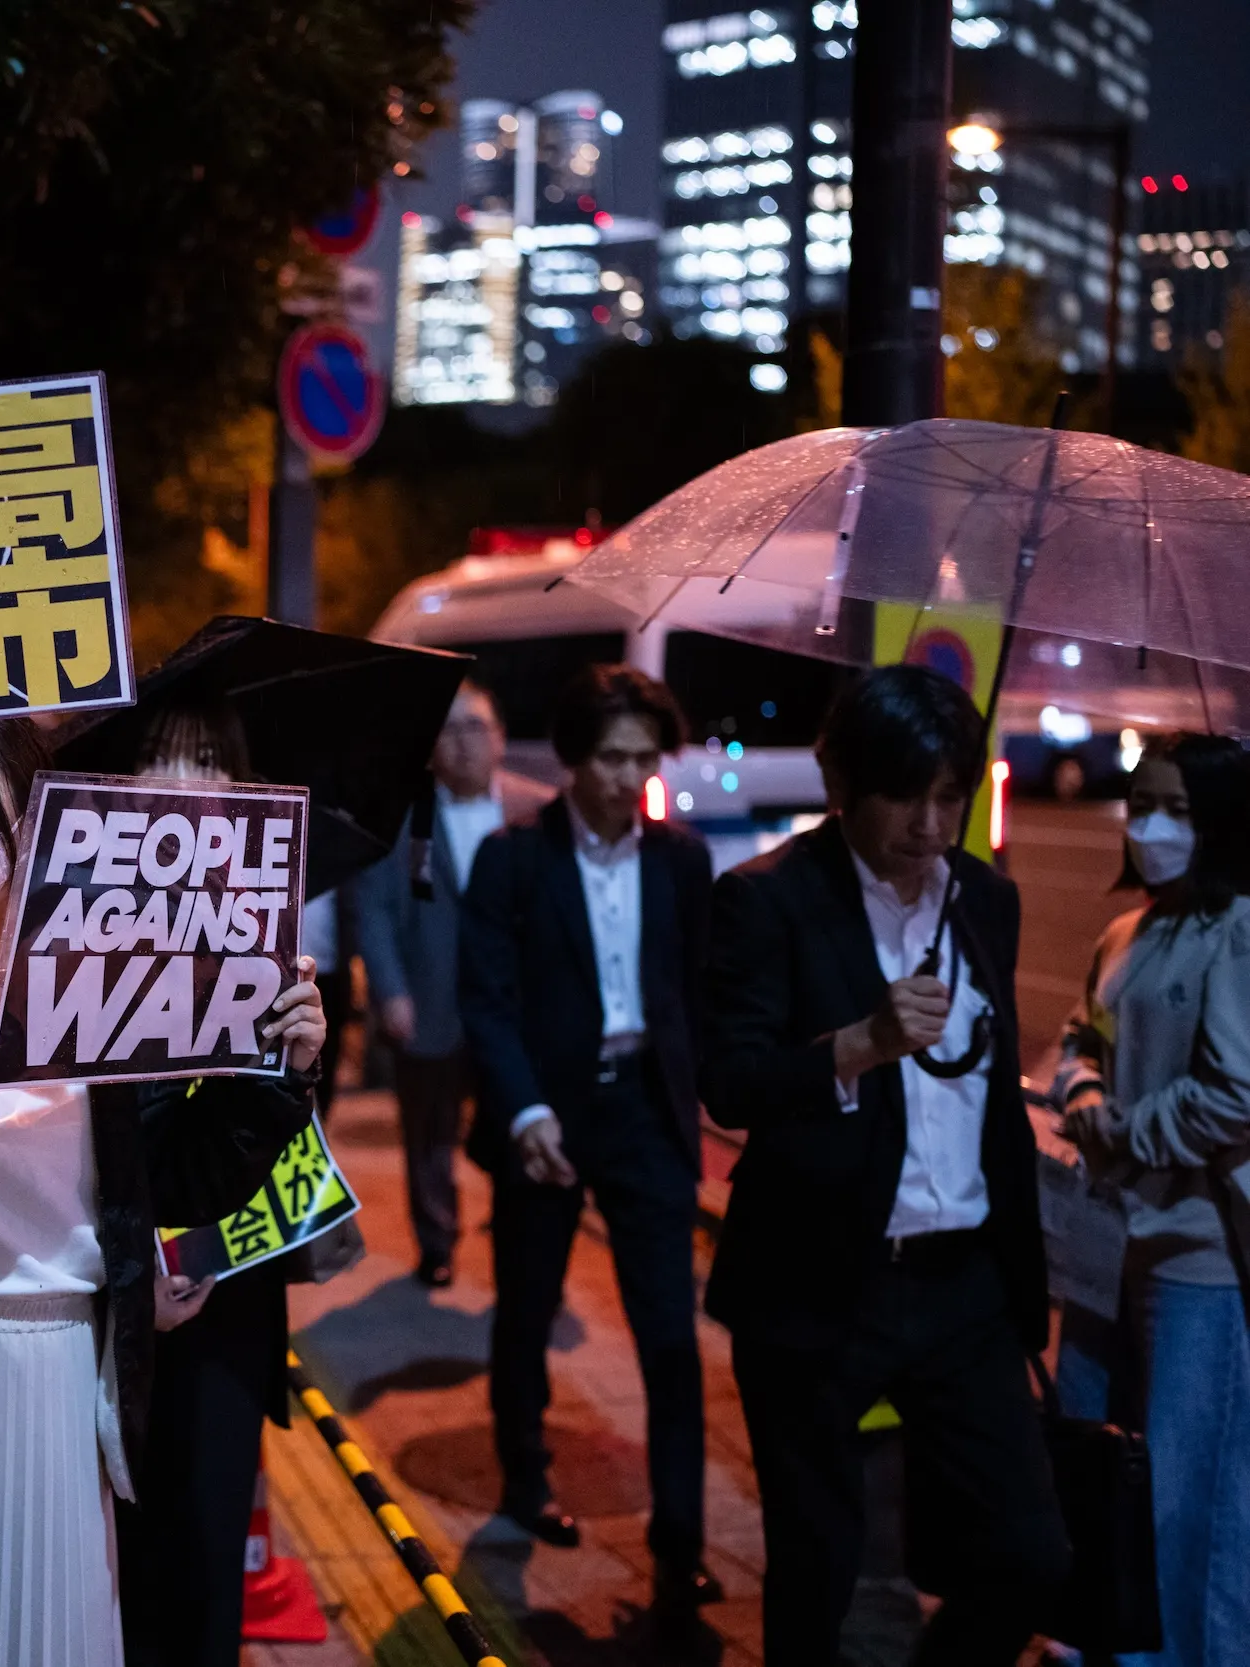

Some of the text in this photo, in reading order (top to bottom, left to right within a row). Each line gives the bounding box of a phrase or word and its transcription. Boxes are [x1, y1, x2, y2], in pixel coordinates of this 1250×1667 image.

[44, 808, 294, 888] PEOPLE
[30, 888, 288, 954] AGAINST
[26, 956, 282, 1066] WAR
